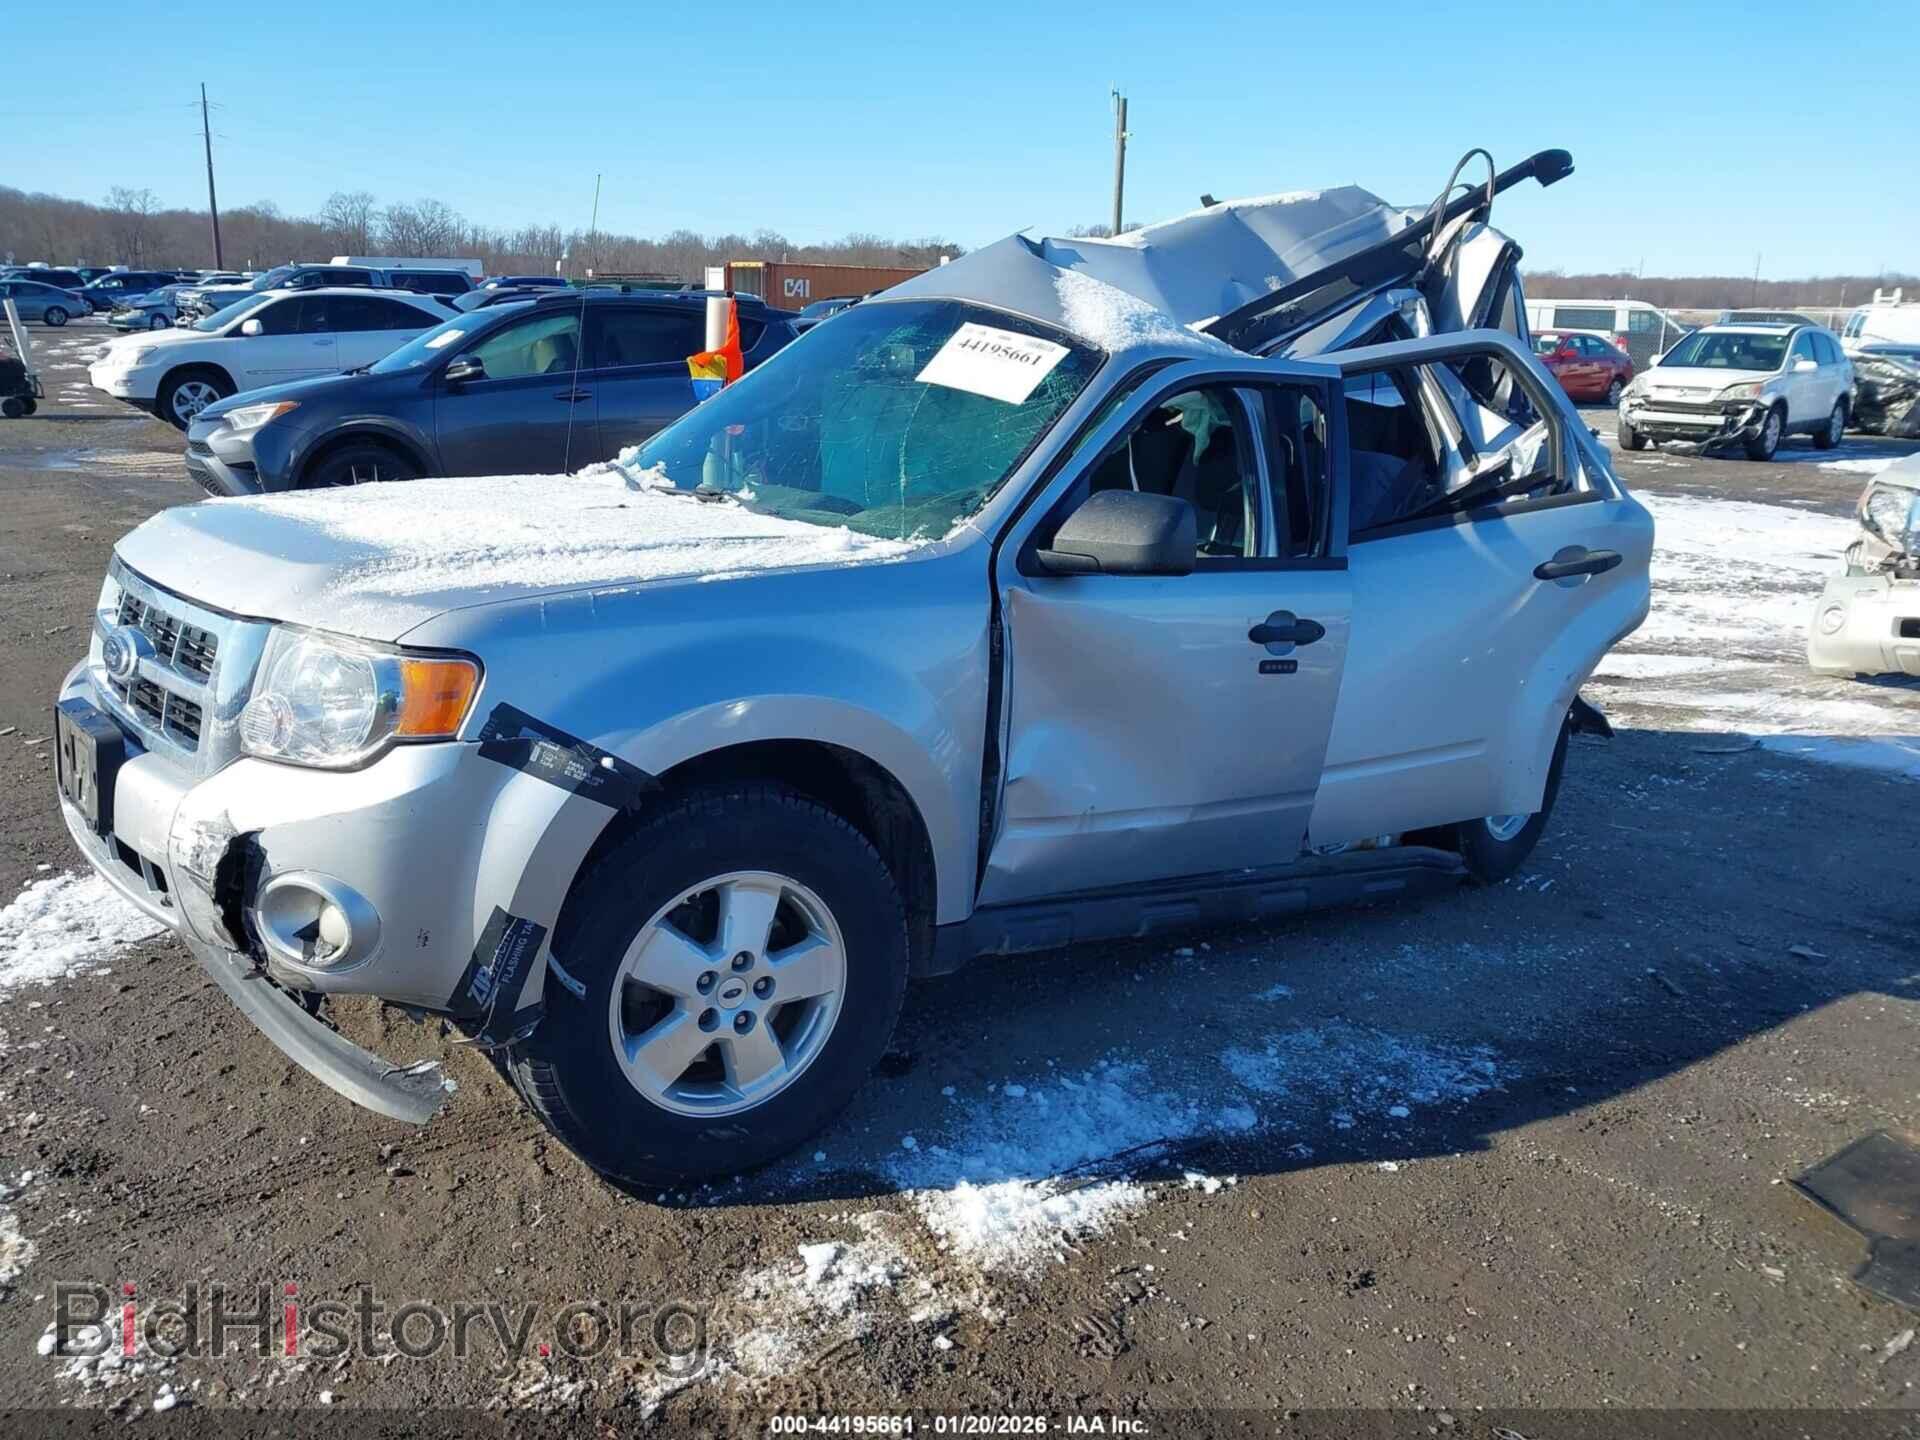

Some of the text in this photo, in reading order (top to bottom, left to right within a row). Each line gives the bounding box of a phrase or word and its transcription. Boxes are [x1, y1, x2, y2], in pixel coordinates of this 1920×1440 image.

[784, 278, 810, 297] CAI
[958, 338, 1042, 366] 44195661
[467, 966, 490, 1005] ZIP
